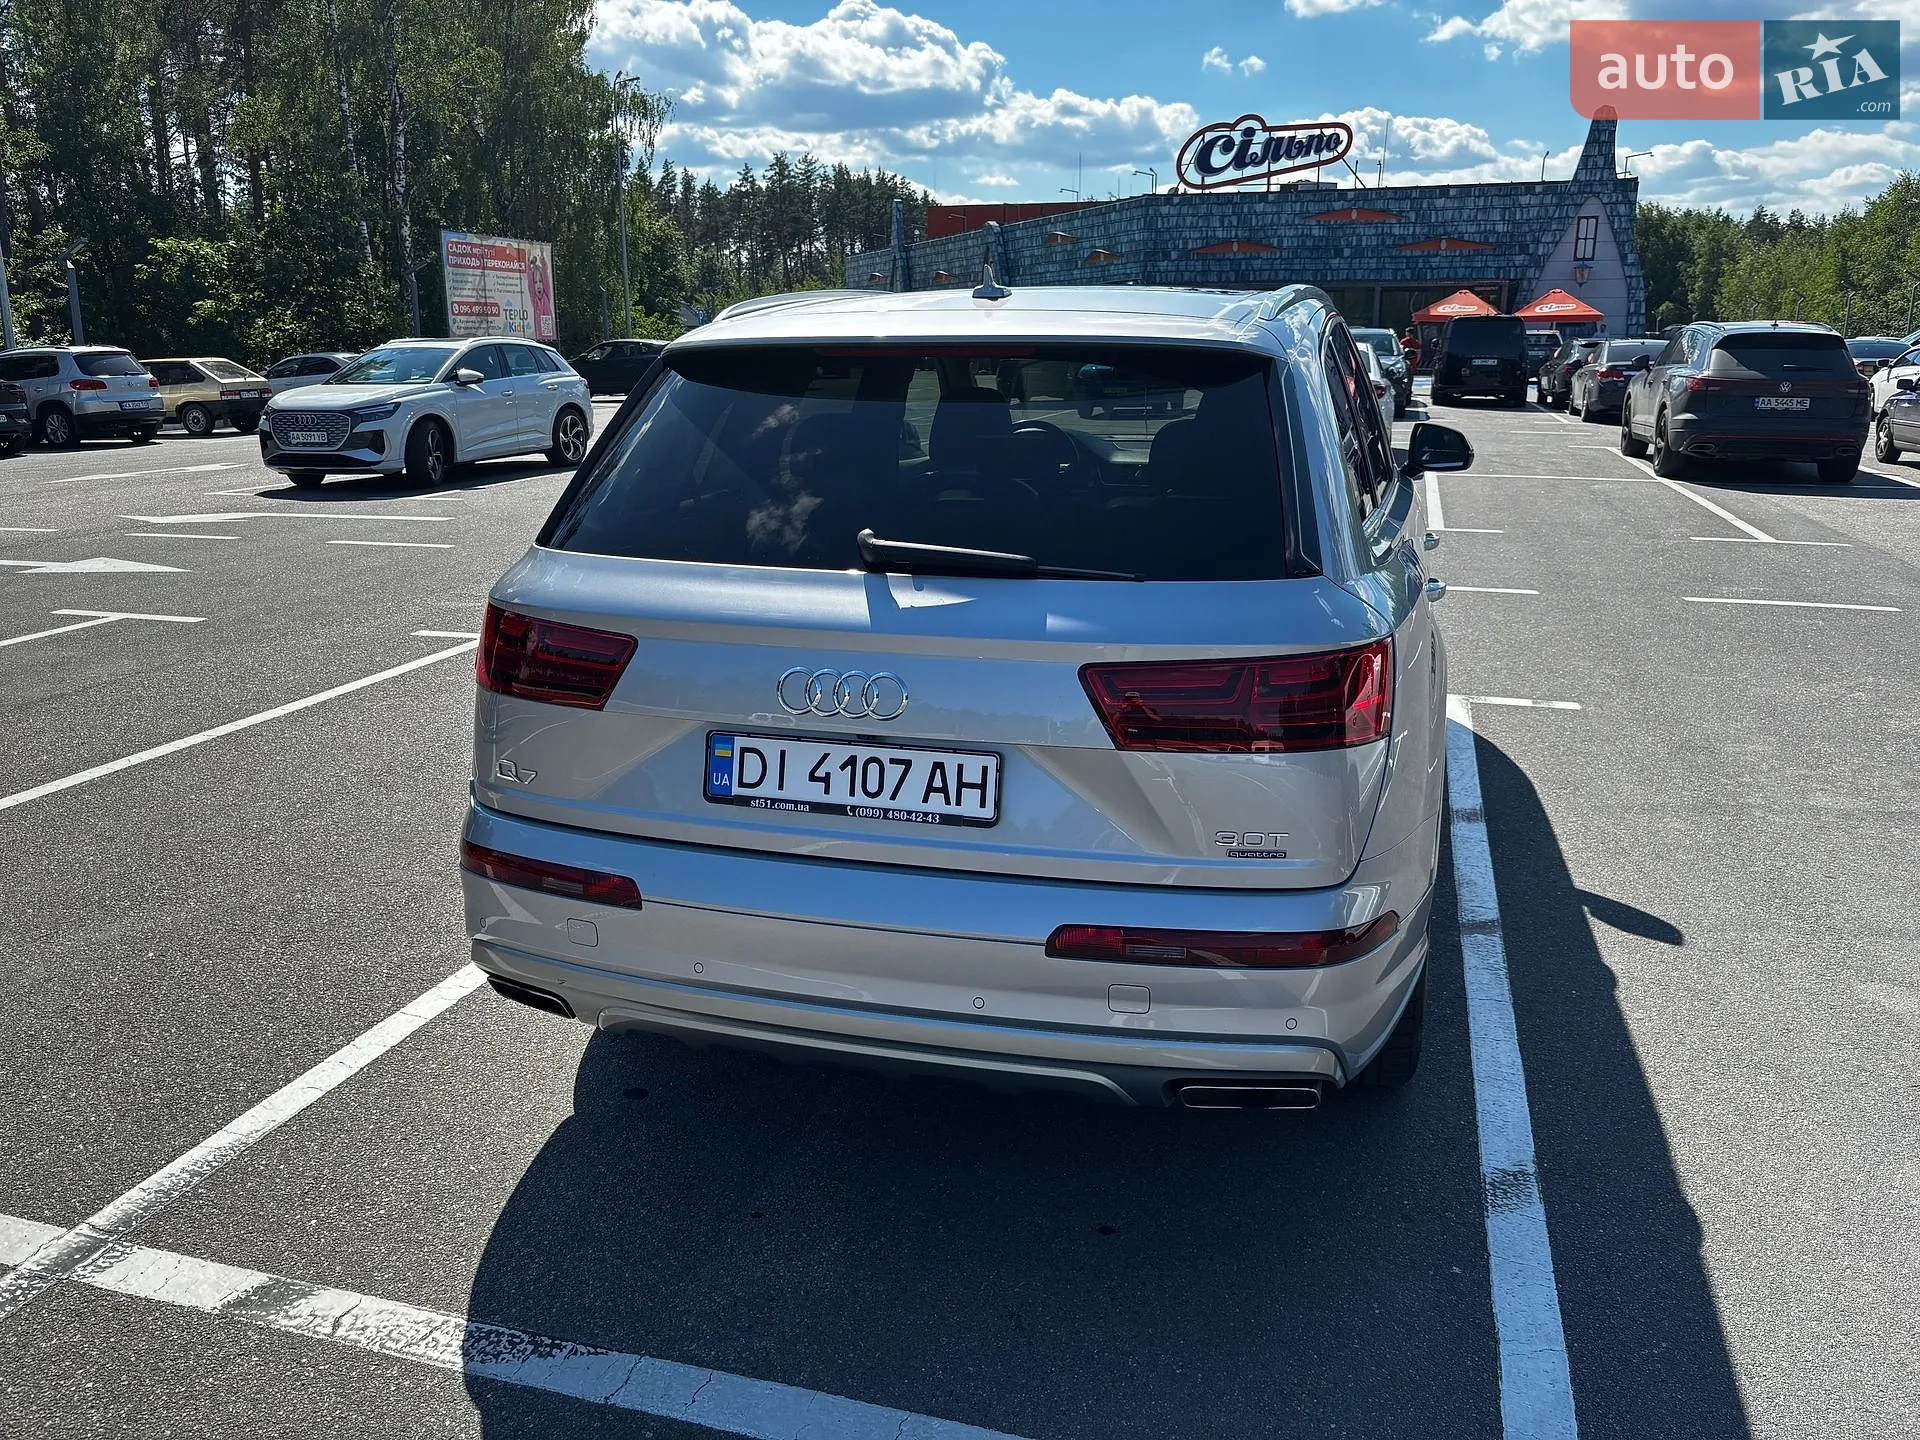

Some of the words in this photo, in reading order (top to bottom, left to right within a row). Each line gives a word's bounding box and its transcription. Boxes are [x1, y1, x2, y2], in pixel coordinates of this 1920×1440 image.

[1194, 126, 1344, 177] Сільпо
[448, 255, 480, 267] ПРИХОДЬ
[484, 259, 526, 271] ПЕРЕКОНАЙСЯ
[503, 308, 529, 321] TEPLO
[1760, 398, 1772, 407] AA
[1774, 398, 1794, 407] 5445
[496, 759, 537, 785] Q7
[713, 772, 731, 787] UA
[737, 746, 787, 792] DI
[808, 752, 912, 802] 4107
[922, 761, 989, 809] AH
[750, 799, 810, 812] st51.com.ua
[855, 807, 884, 820] (099)
[886, 809, 940, 824] 480-42-43
[1215, 831, 1289, 848] 3.0T
